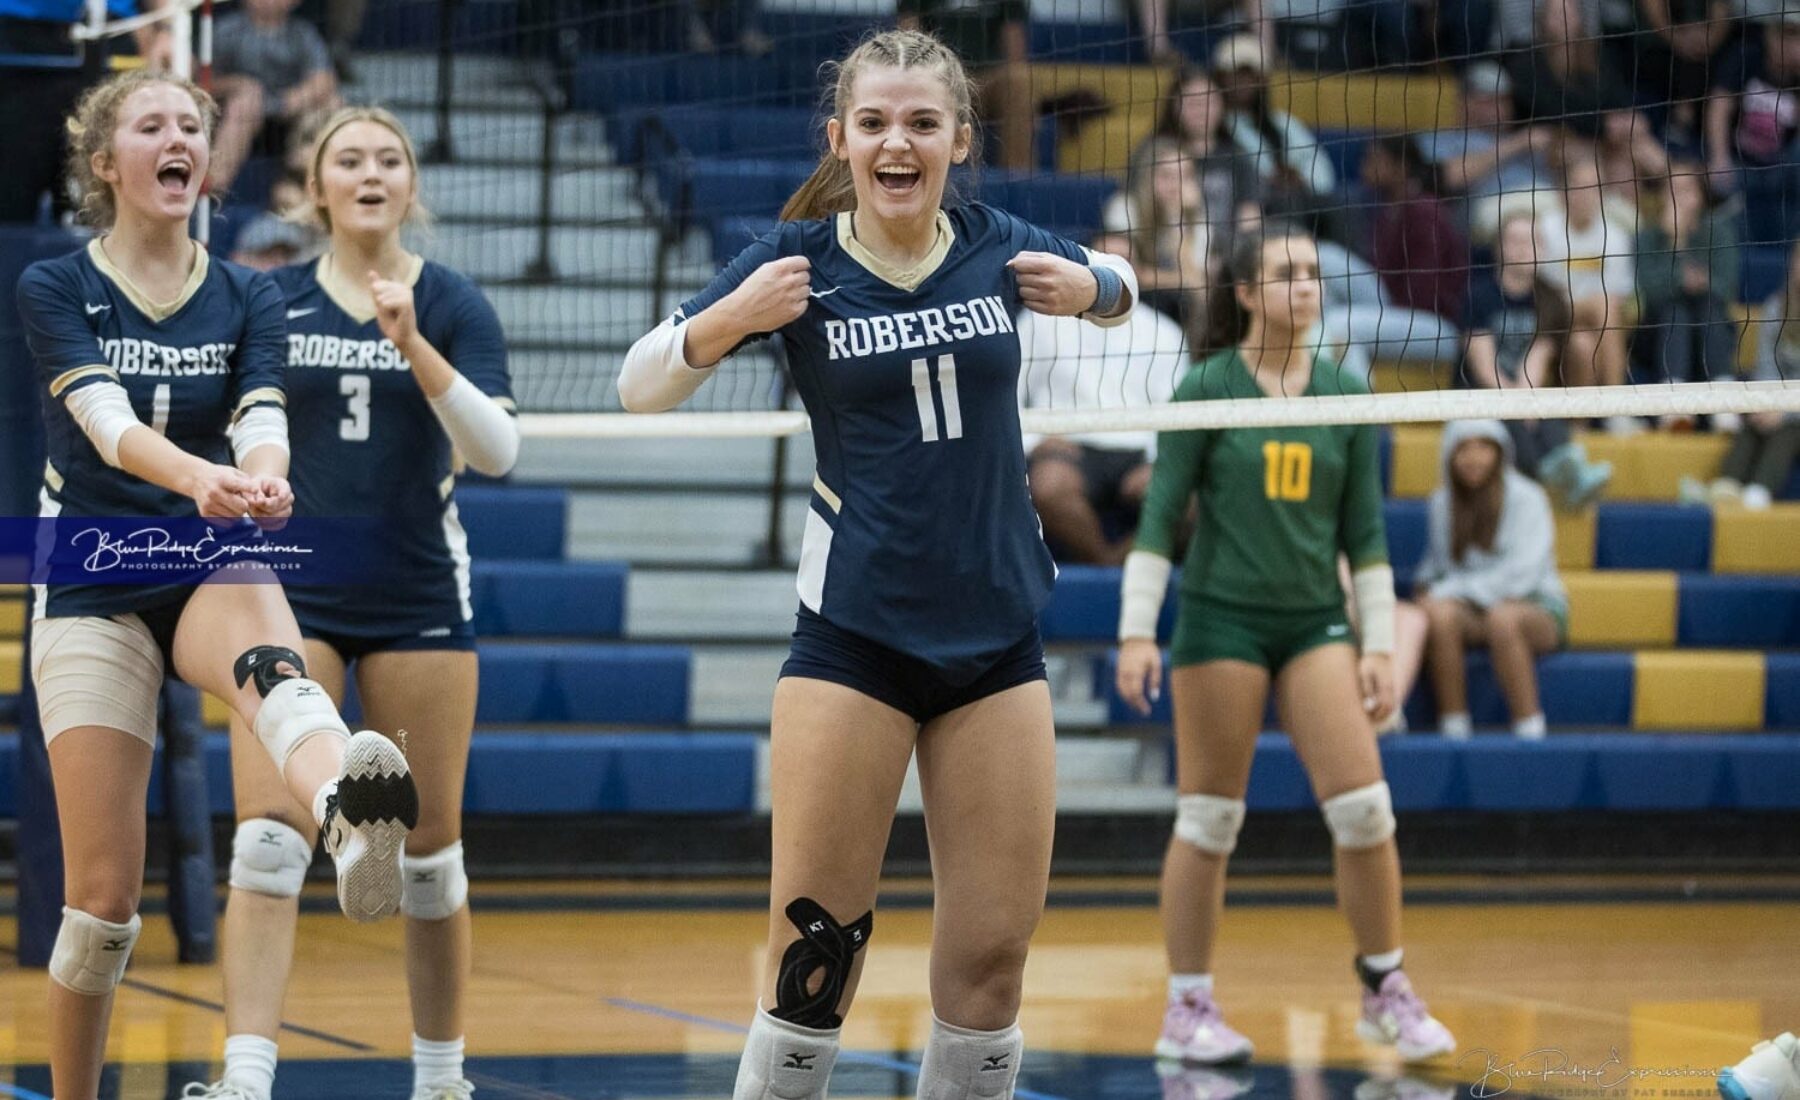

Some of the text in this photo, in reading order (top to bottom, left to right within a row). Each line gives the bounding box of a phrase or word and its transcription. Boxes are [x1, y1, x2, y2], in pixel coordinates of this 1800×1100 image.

[96, 336, 236, 376] OBERSON
[825, 295, 1014, 360] ROBERSON
[151, 384, 170, 437] 1
[340, 374, 371, 441] 3
[911, 353, 963, 442] 11
[1263, 440, 1312, 502] 10
